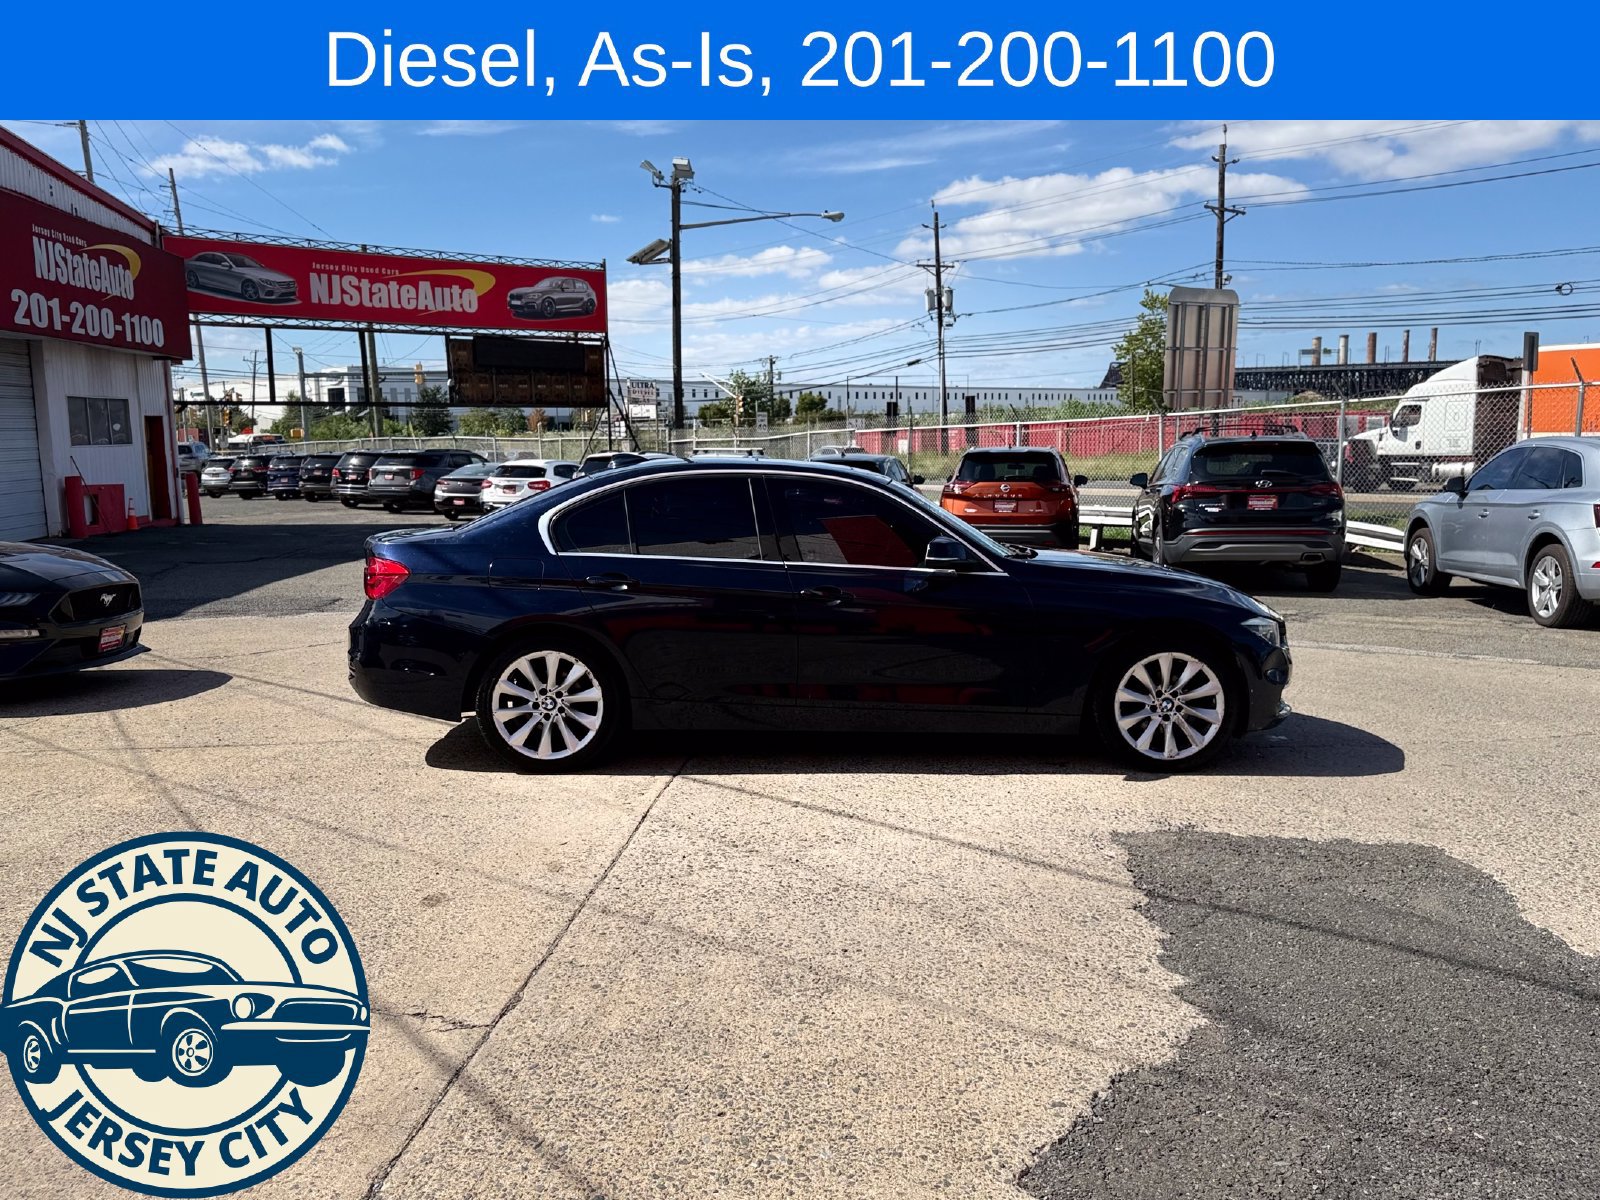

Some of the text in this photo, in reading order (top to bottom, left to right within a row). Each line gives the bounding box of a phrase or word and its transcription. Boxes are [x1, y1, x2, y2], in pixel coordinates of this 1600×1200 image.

[32, 223, 50, 237] Jersey
[51, 229, 62, 241] City
[32, 235, 135, 301] NJStateAuto
[312, 262, 400, 275] Jersey City Used Cars
[309, 272, 479, 313] NJStateAuto
[11, 288, 165, 348] 201-200-1100
[631, 381, 655, 389] ULTRA
